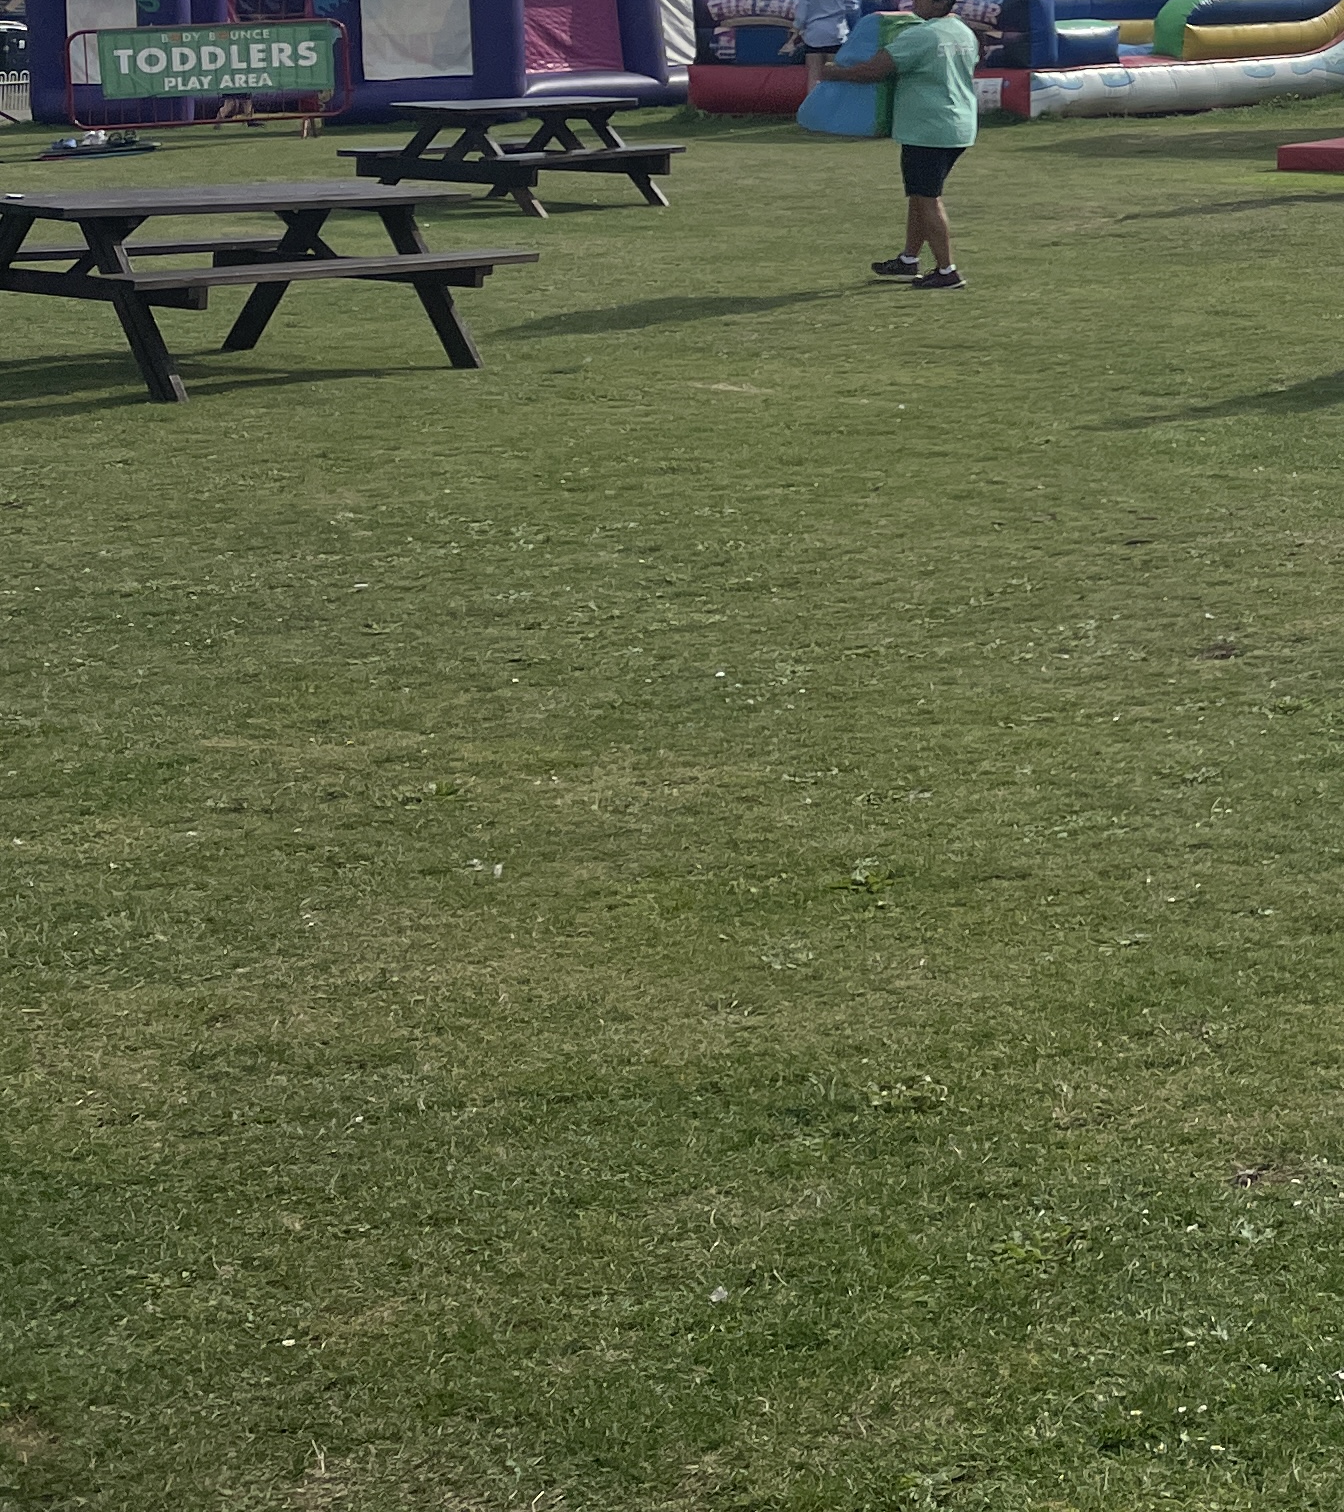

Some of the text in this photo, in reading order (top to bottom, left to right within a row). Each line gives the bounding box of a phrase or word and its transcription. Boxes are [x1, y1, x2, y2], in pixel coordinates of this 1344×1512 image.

[208, 29, 270, 42] BOUNCE
[113, 41, 317, 74] TODDLERS
[164, 73, 273, 91] PLAY AREA
